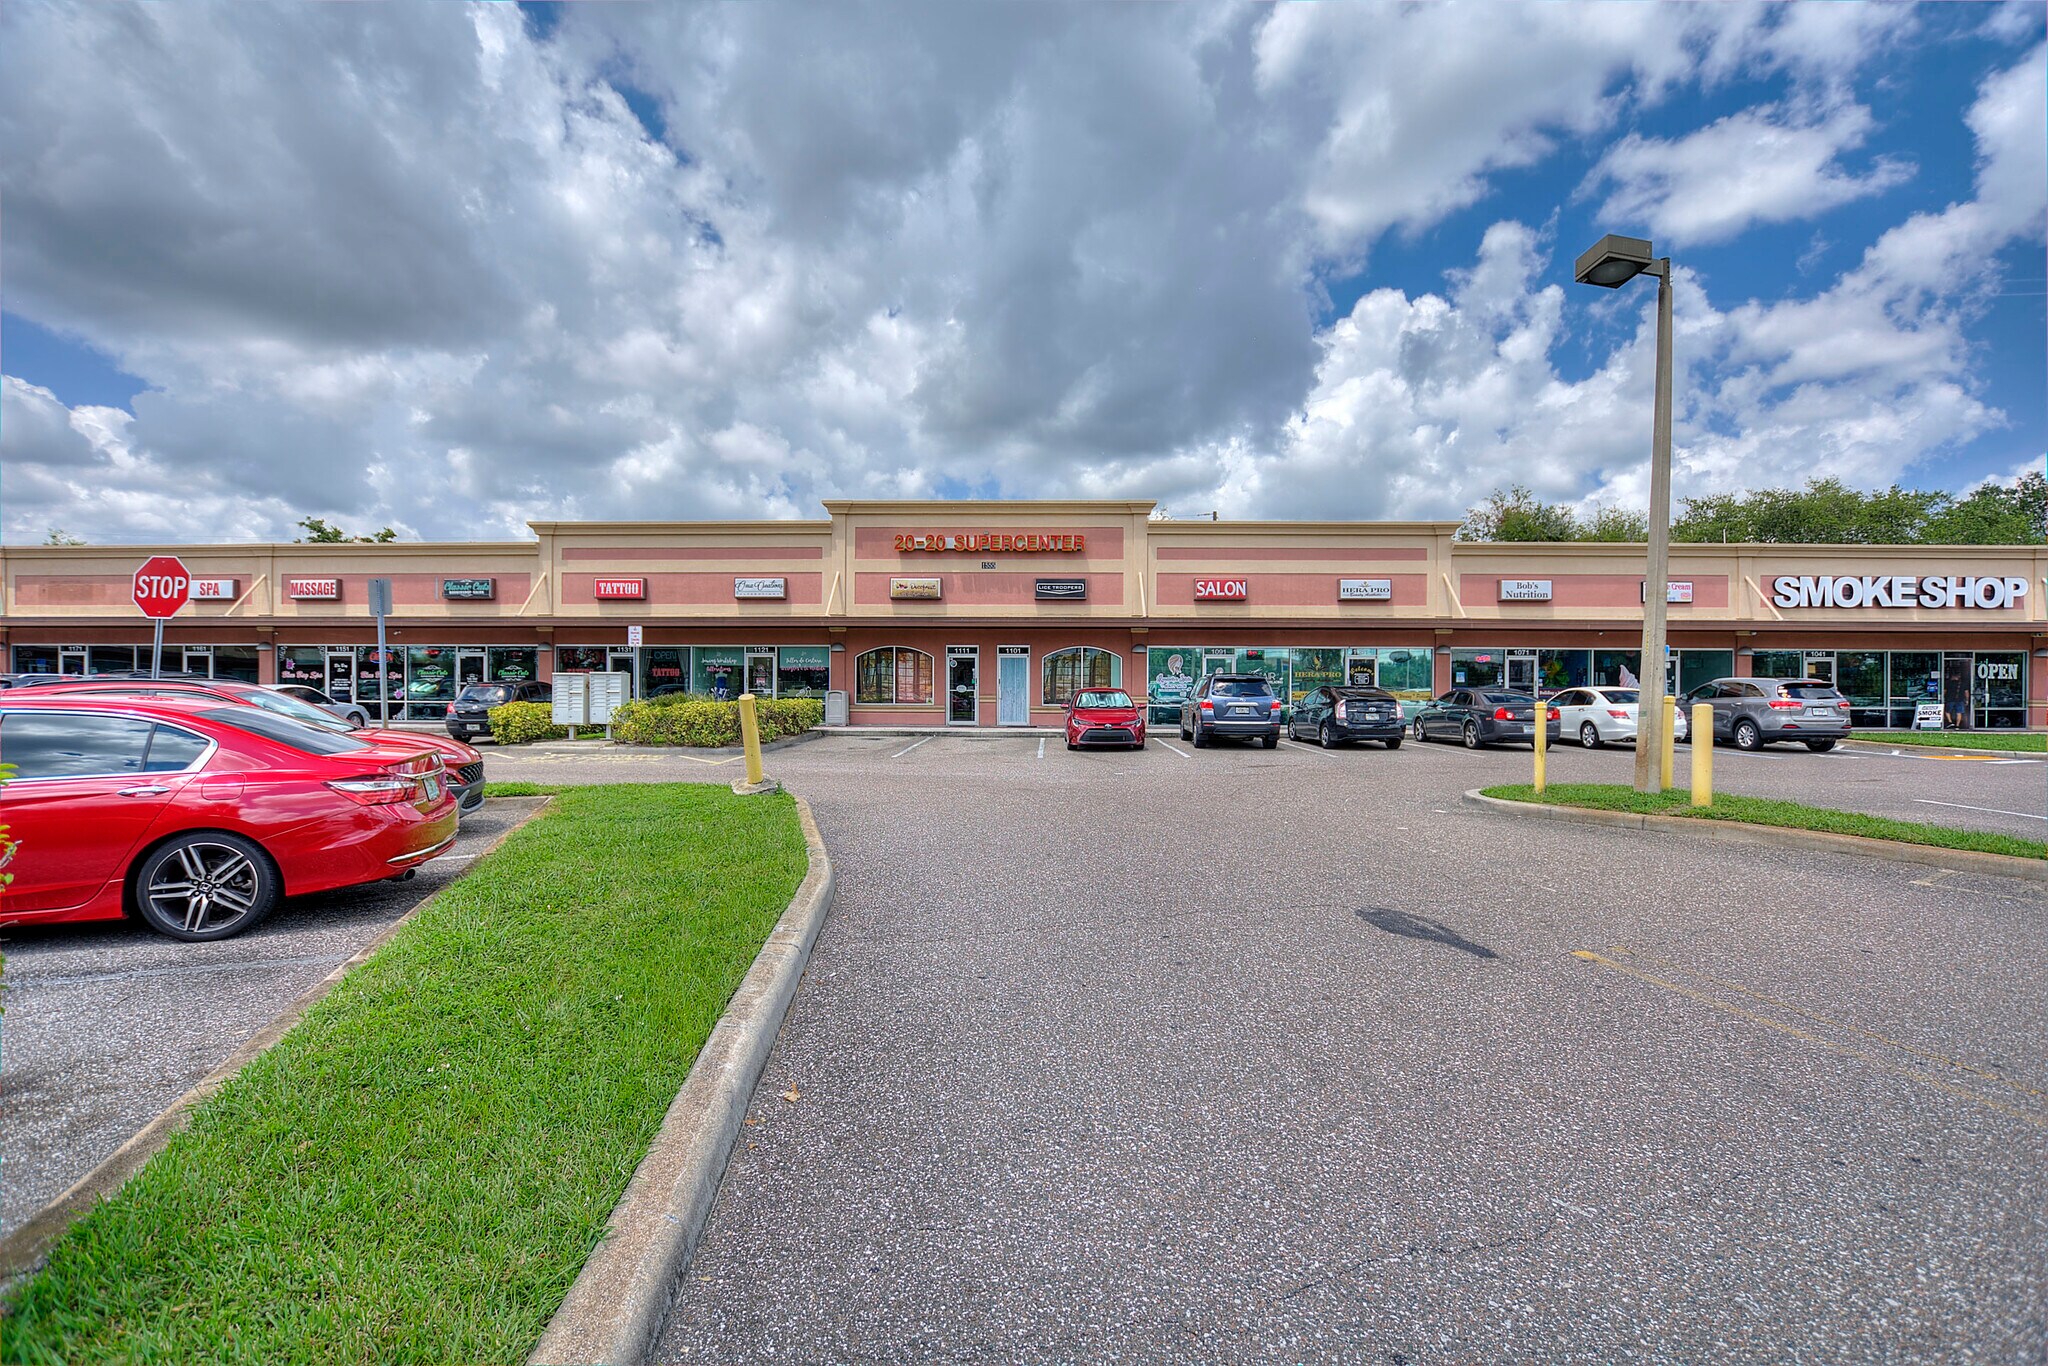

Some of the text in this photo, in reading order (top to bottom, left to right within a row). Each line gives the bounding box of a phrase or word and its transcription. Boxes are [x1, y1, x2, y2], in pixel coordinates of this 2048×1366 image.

[894, 534, 1086, 551] 20-20 SUPERCENTER
[136, 575, 187, 599] STOP
[199, 582, 220, 596] SPA
[290, 582, 336, 597] MASSAGE
[443, 581, 490, 591] Classic Cuts
[598, 582, 639, 595] TATTOO
[1196, 581, 1246, 596] SALON
[1516, 581, 1539, 590] Bob's
[1671, 583, 1691, 591] Cream
[1773, 575, 2029, 609] SMOKE SHOP
[1505, 590, 1549, 598] Nutrition
[652, 668, 680, 677] TATTOO
[1978, 663, 2019, 680] OPEN
